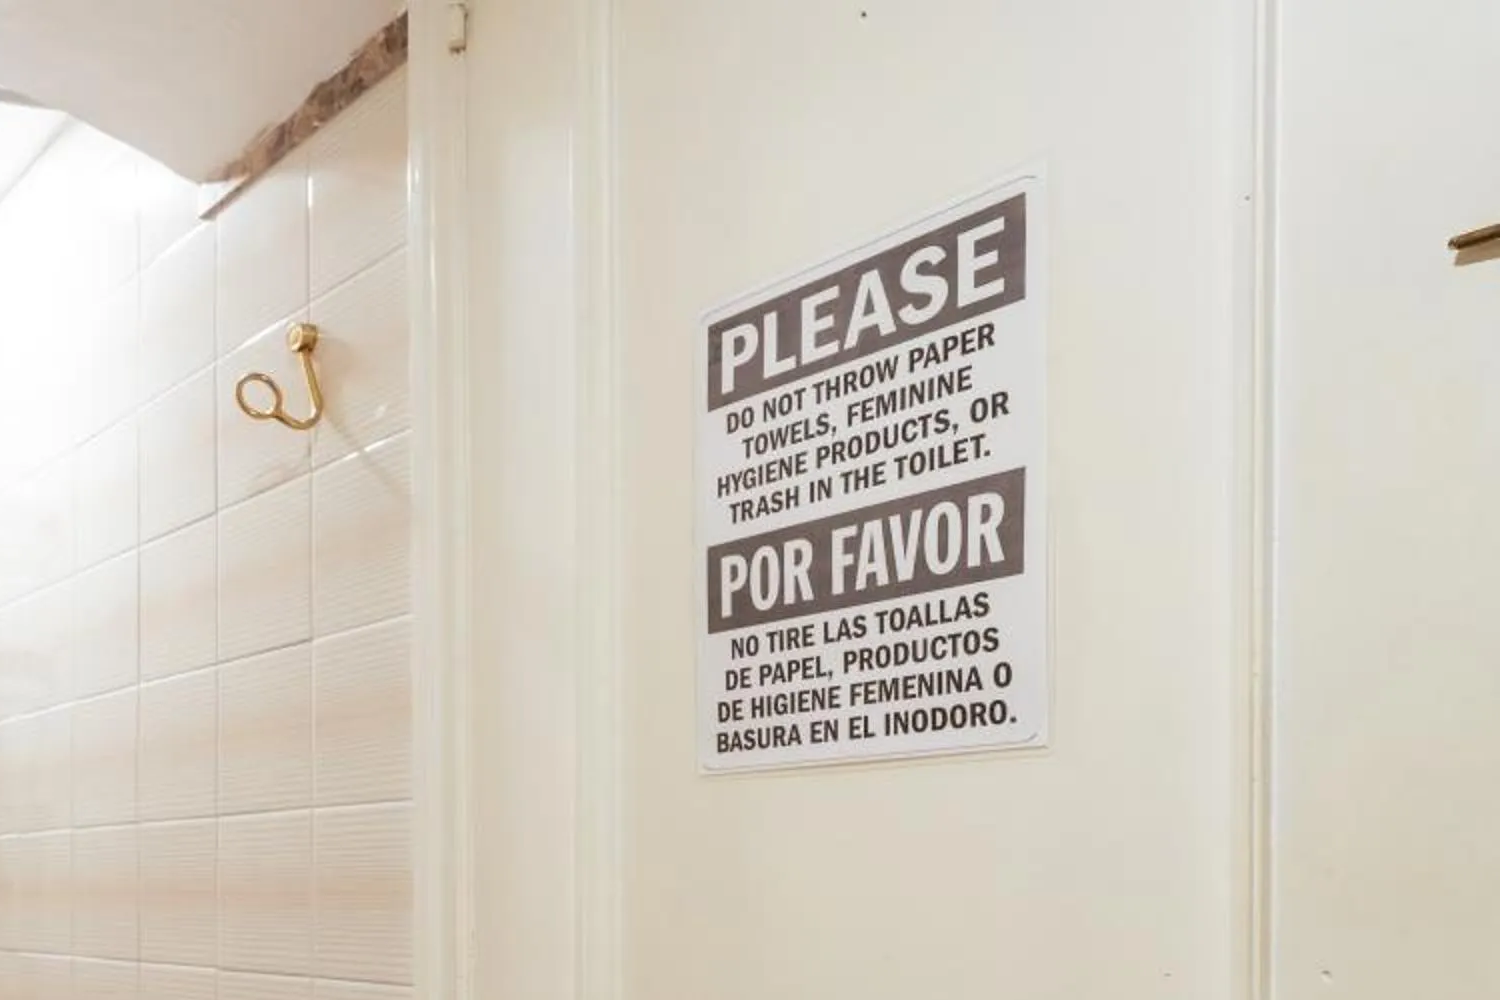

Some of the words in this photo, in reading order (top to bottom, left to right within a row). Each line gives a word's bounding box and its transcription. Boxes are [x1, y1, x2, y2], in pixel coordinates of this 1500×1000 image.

[721, 216, 1005, 395] PLEASE
[726, 407, 755, 434] DO
[763, 387, 807, 422] NOT
[812, 355, 900, 404] THROW
[908, 322, 996, 373] PAPER
[742, 412, 837, 459] TOWELS,
[846, 365, 973, 428] FEMININE
[717, 453, 808, 498] HYGIENE
[816, 409, 959, 469] PRODUCTS,
[970, 390, 1010, 424] OR
[729, 486, 800, 525] TRASH
[809, 476, 833, 503] IN
[840, 465, 887, 495] THE
[893, 432, 992, 481] TOILET.
[721, 538, 815, 619] POR
[831, 491, 1005, 596] FAVOR
[725, 666, 752, 691] DE
[759, 657, 834, 687] PAPEL,
[843, 627, 1000, 674] PRODUCTOS
[731, 635, 760, 660] NO
[766, 624, 815, 653] TIRE
[823, 615, 867, 645] LAS
[875, 591, 991, 634] TOALLAS
[716, 724, 802, 753] BASURA
[810, 719, 839, 744] EN
[849, 715, 876, 740] EL
[885, 700, 1017, 736] INODORO.
[717, 699, 745, 723] DE
[751, 685, 841, 719] HIGIENE
[850, 666, 983, 707] FEMENINA
[993, 661, 1013, 689] O
